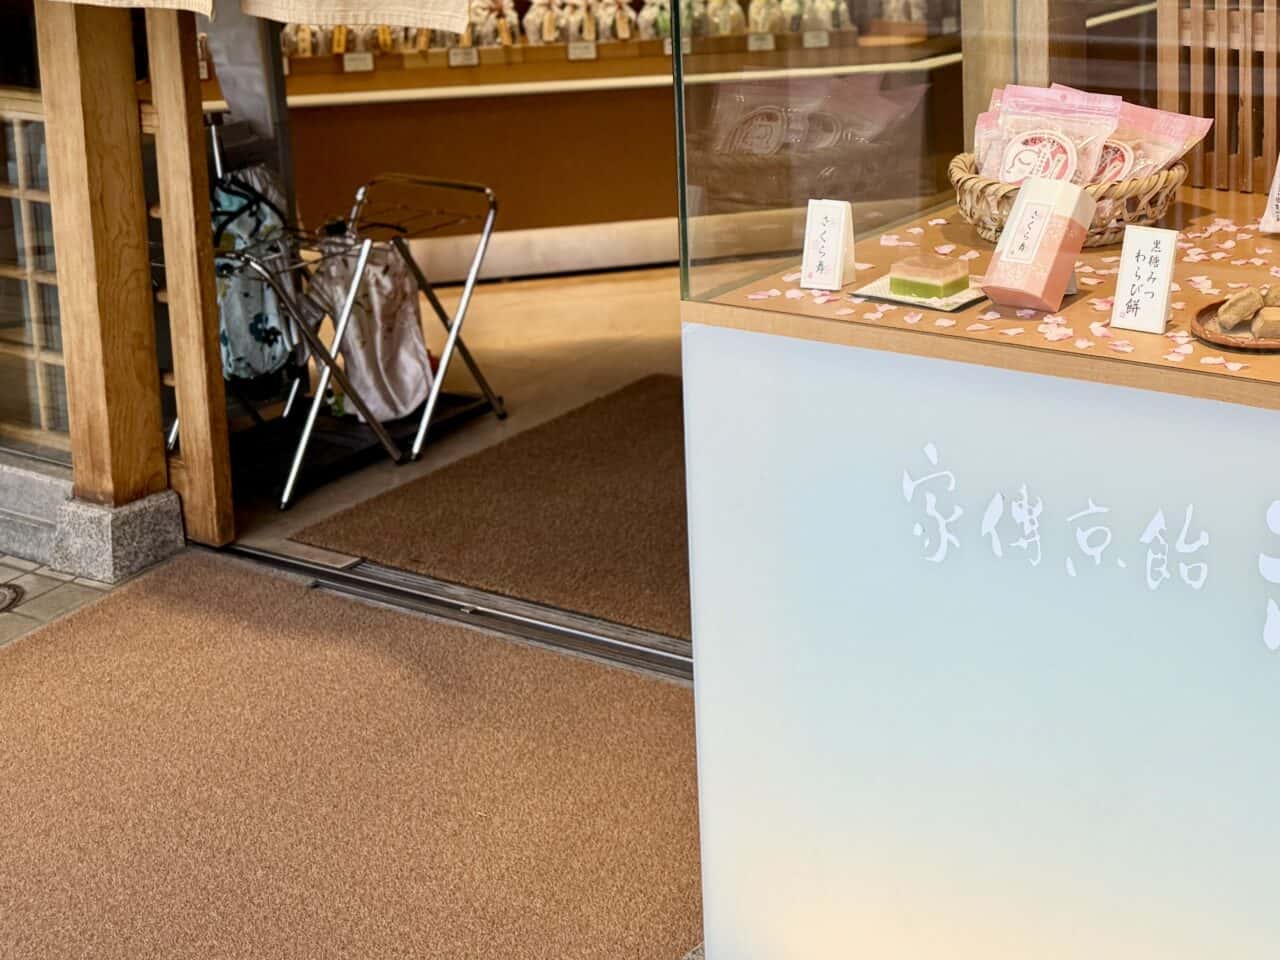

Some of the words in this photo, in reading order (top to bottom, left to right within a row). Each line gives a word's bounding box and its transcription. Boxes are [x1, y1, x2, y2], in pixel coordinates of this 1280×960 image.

[1125, 249, 1146, 317] わらび餅
[1144, 239, 1162, 299] 黒糖みつ
[902, 442, 1210, 591] 家傳京飴
